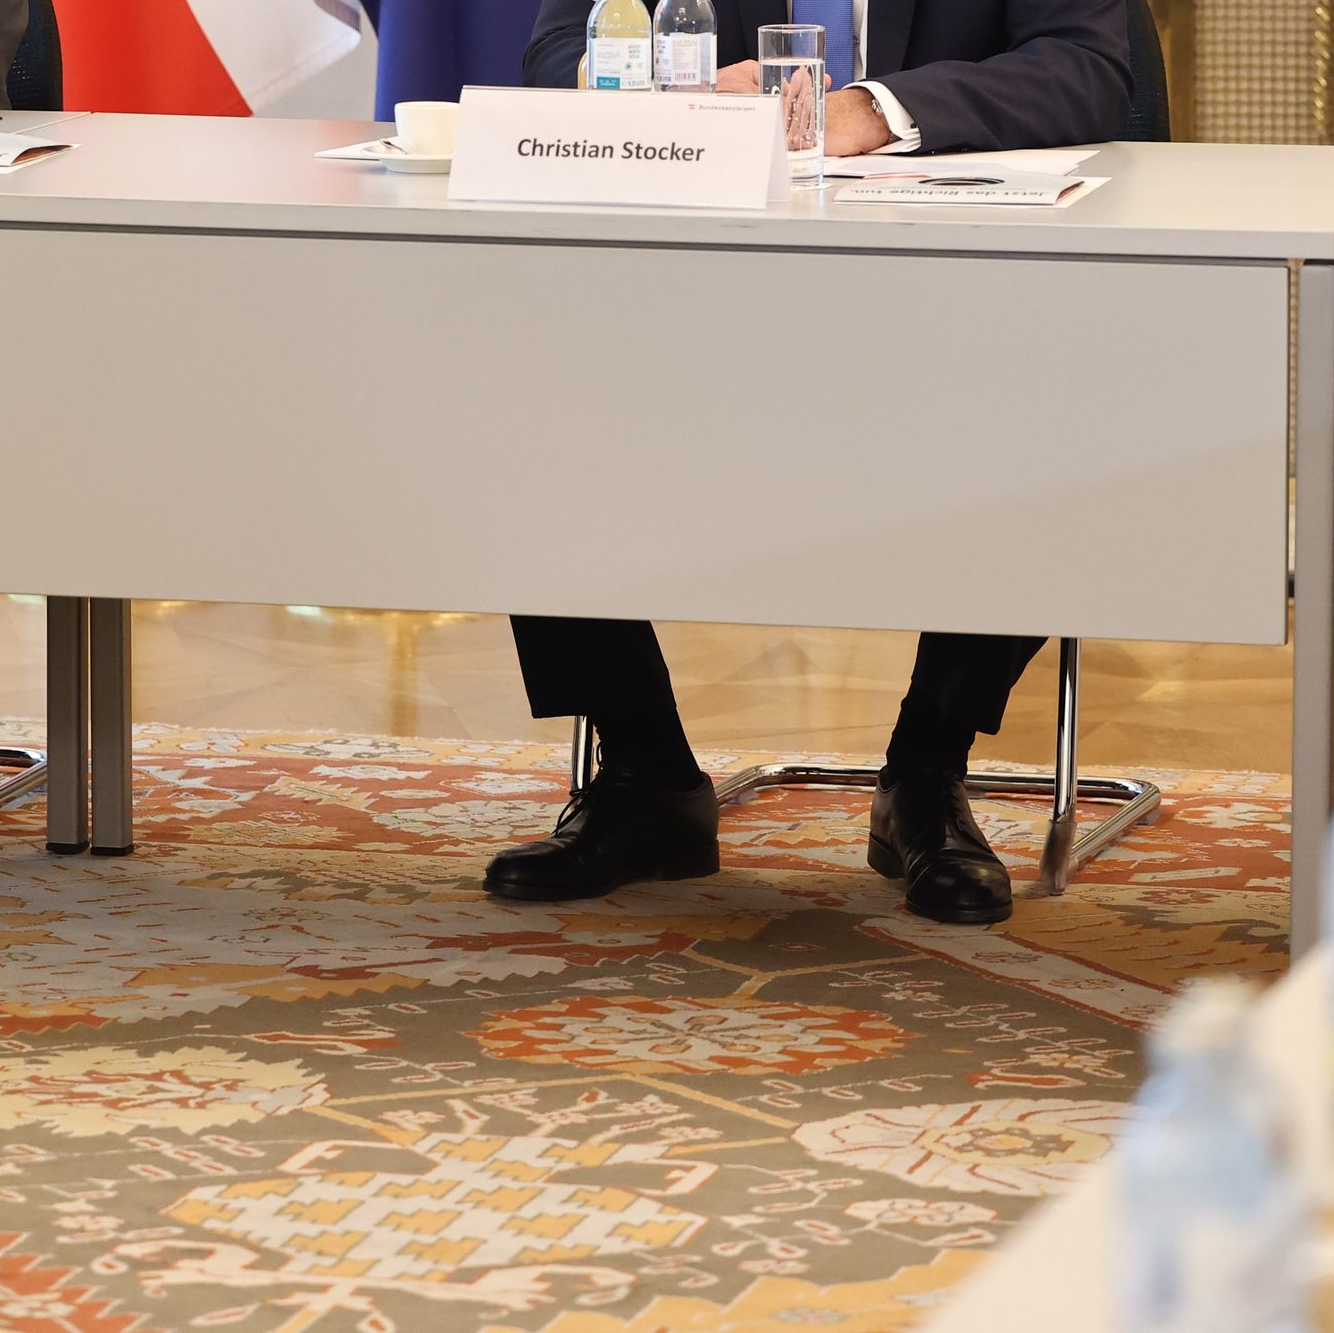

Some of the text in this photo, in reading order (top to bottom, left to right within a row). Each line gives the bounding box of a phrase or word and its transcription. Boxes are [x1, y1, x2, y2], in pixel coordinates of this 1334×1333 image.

[698, 104, 757, 112] Bundeskanzleramt
[517, 138, 705, 162] Christian Stocker
